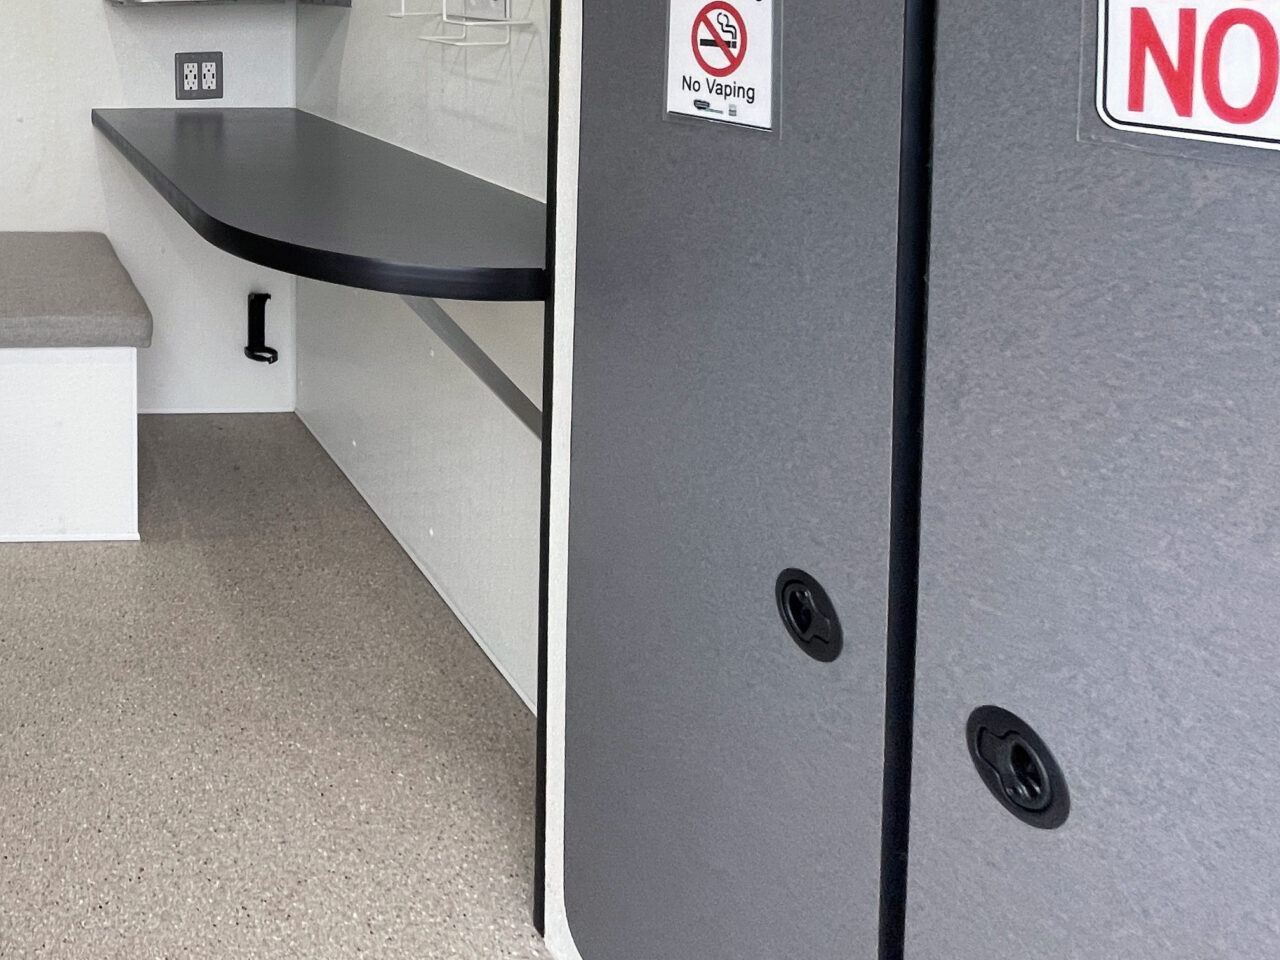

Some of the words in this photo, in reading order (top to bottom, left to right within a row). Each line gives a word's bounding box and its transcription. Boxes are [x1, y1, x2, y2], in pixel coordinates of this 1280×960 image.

[682, 75, 701, 92] No
[706, 77, 756, 104] Vaping
[1128, 7, 1280, 125] NO
